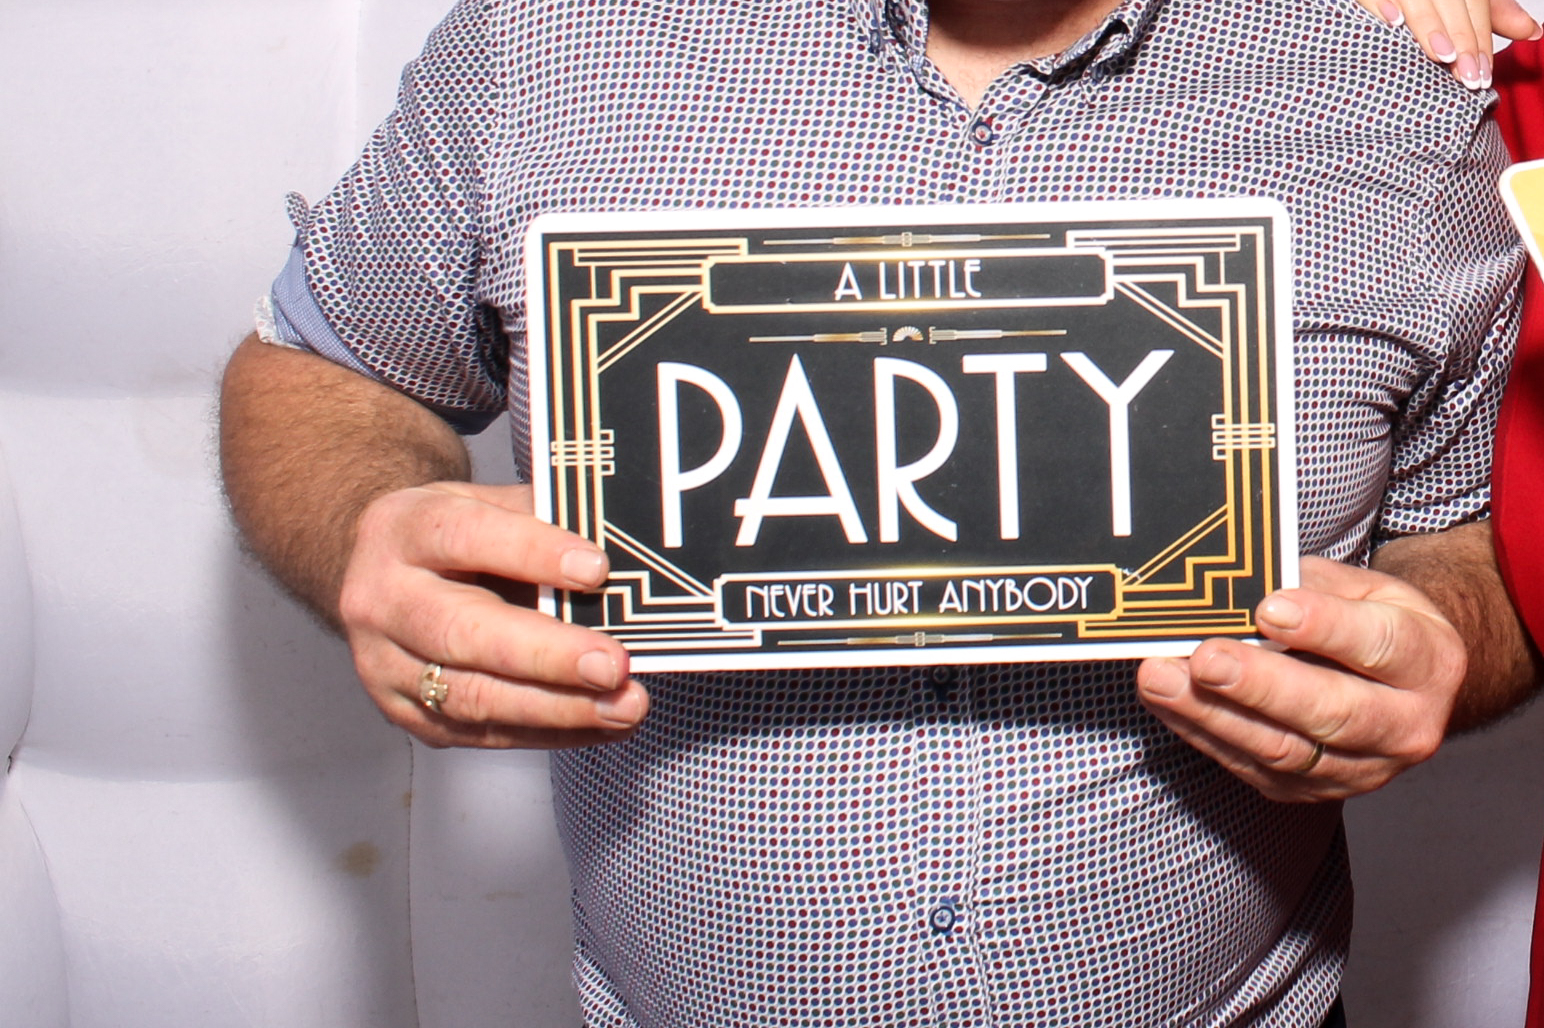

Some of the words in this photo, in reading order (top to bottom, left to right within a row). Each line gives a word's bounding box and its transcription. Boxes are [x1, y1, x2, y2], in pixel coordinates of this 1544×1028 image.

[834, 262, 862, 300] A
[878, 259, 981, 299] LITTLE
[656, 350, 1175, 548] PARTY
[745, 584, 834, 619] NEVER
[849, 581, 923, 616] HURT
[938, 576, 1093, 614] ANYBODY
